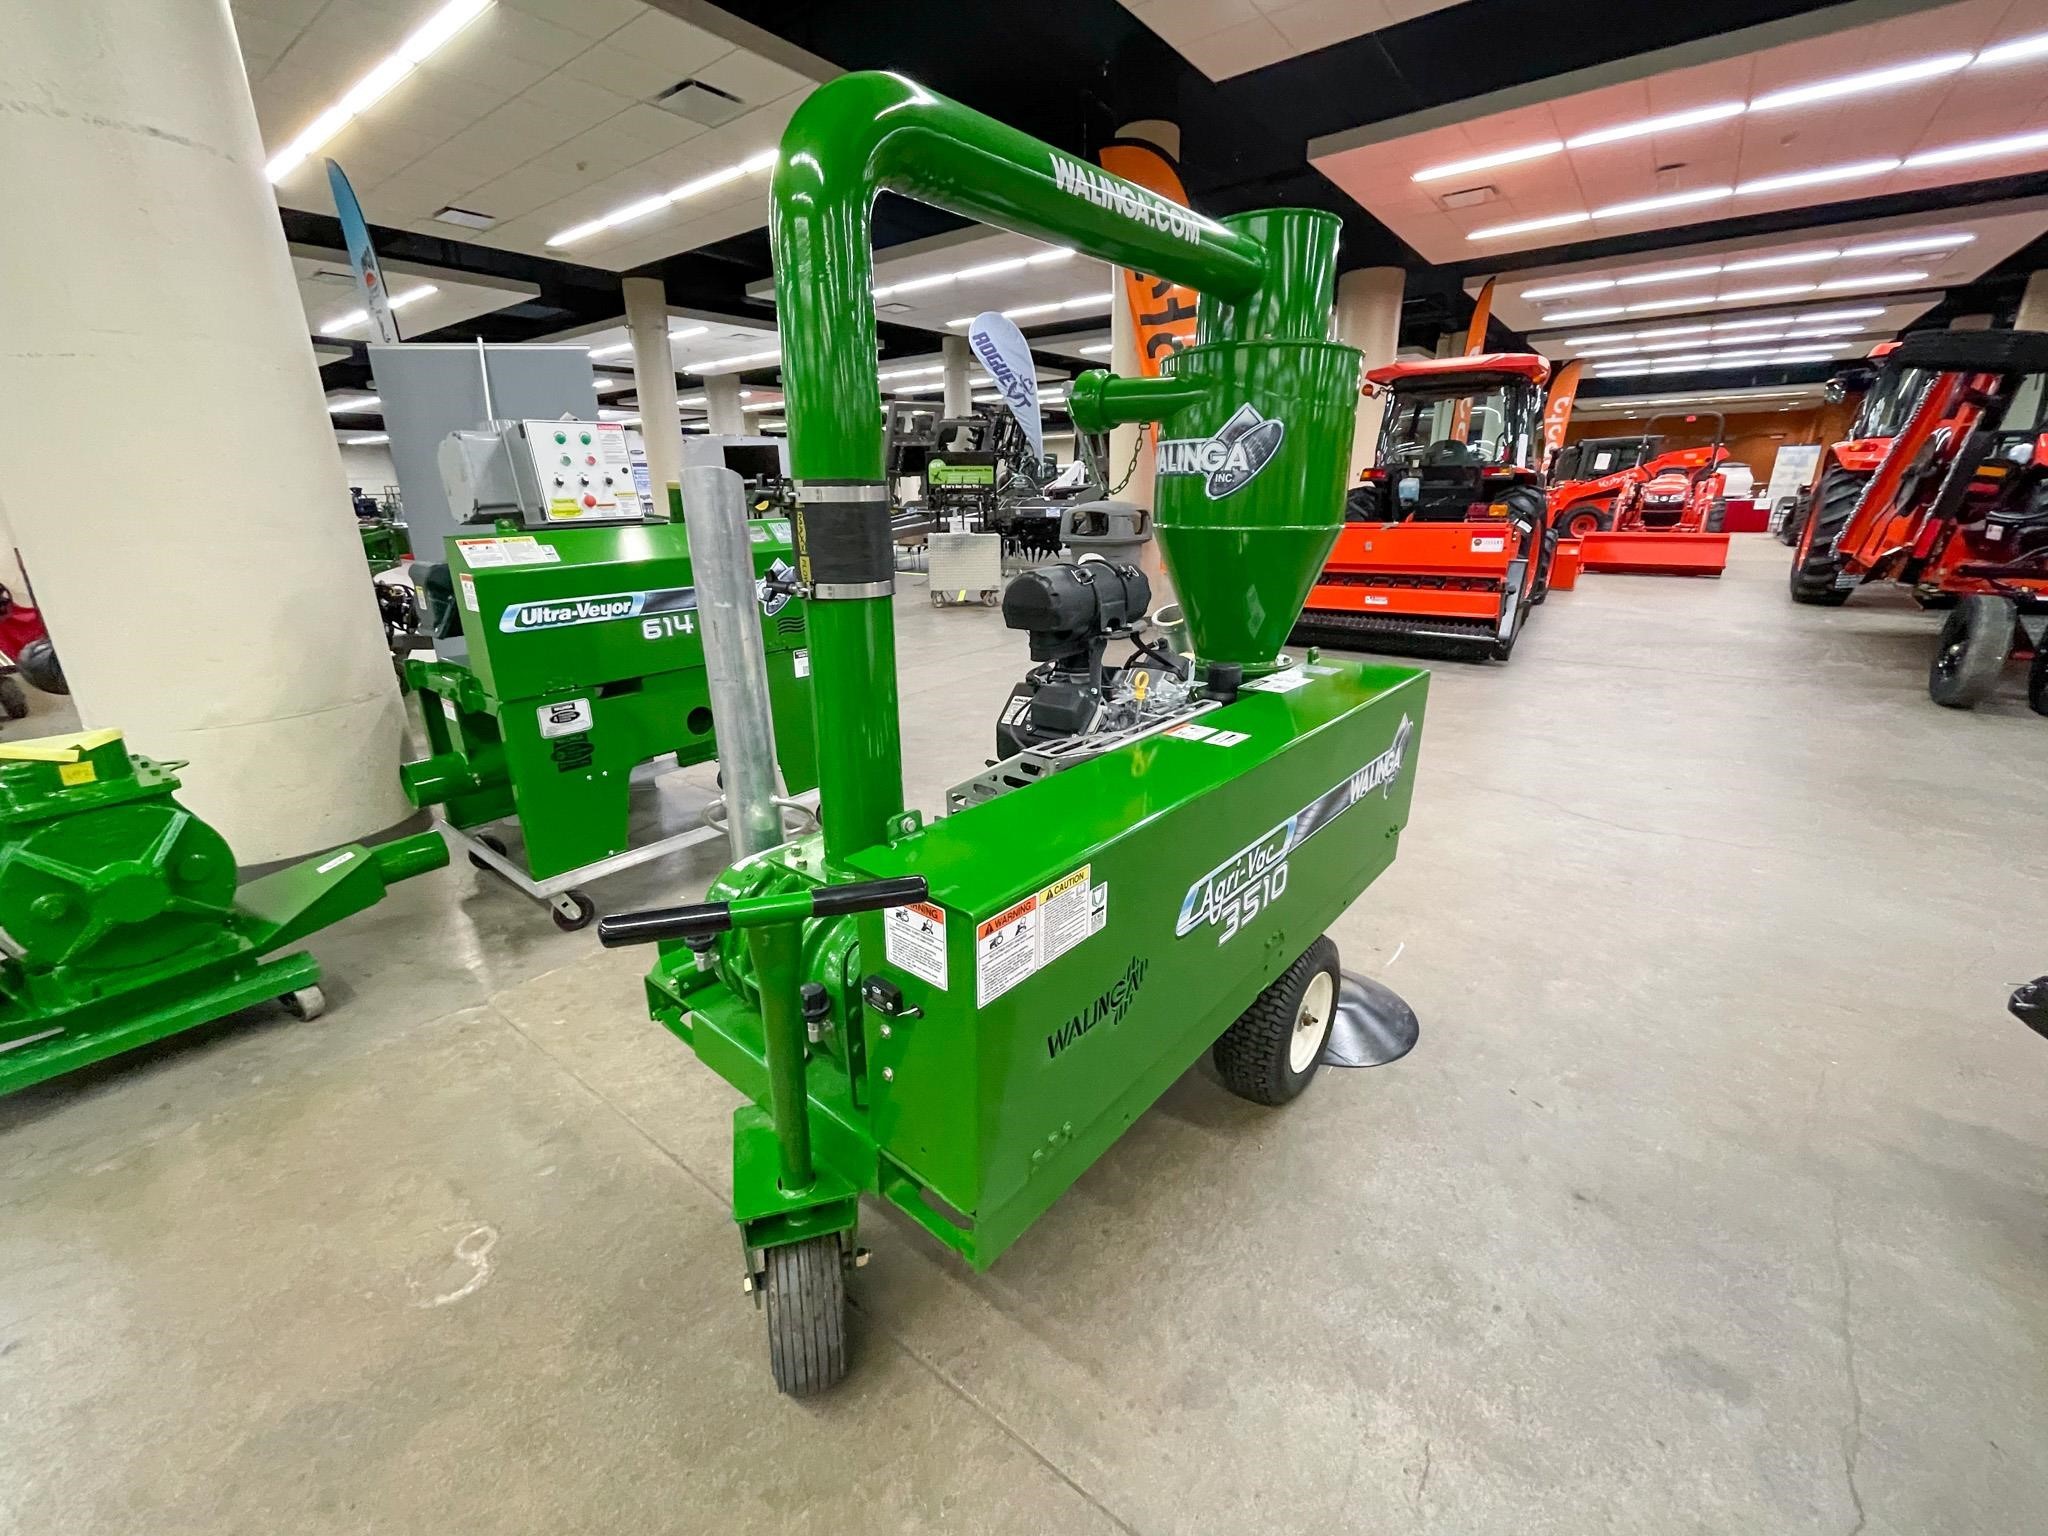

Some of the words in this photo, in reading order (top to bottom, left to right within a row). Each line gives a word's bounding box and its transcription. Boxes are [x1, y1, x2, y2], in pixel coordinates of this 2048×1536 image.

[1049, 153, 1201, 245] WALINGA.COM
[972, 331, 1017, 388] ROGUE
[1156, 439, 1250, 473] ALINGA
[1215, 473, 1235, 483] INC.
[520, 600, 632, 626] Ultra-Veyor
[642, 614, 695, 640] 614
[1350, 746, 1401, 803] WALINGA
[1054, 871, 1085, 895] CAUTION
[1199, 844, 1276, 926] Agri-Vac
[994, 901, 1032, 929] WARNING
[1218, 860, 1288, 947] 3510
